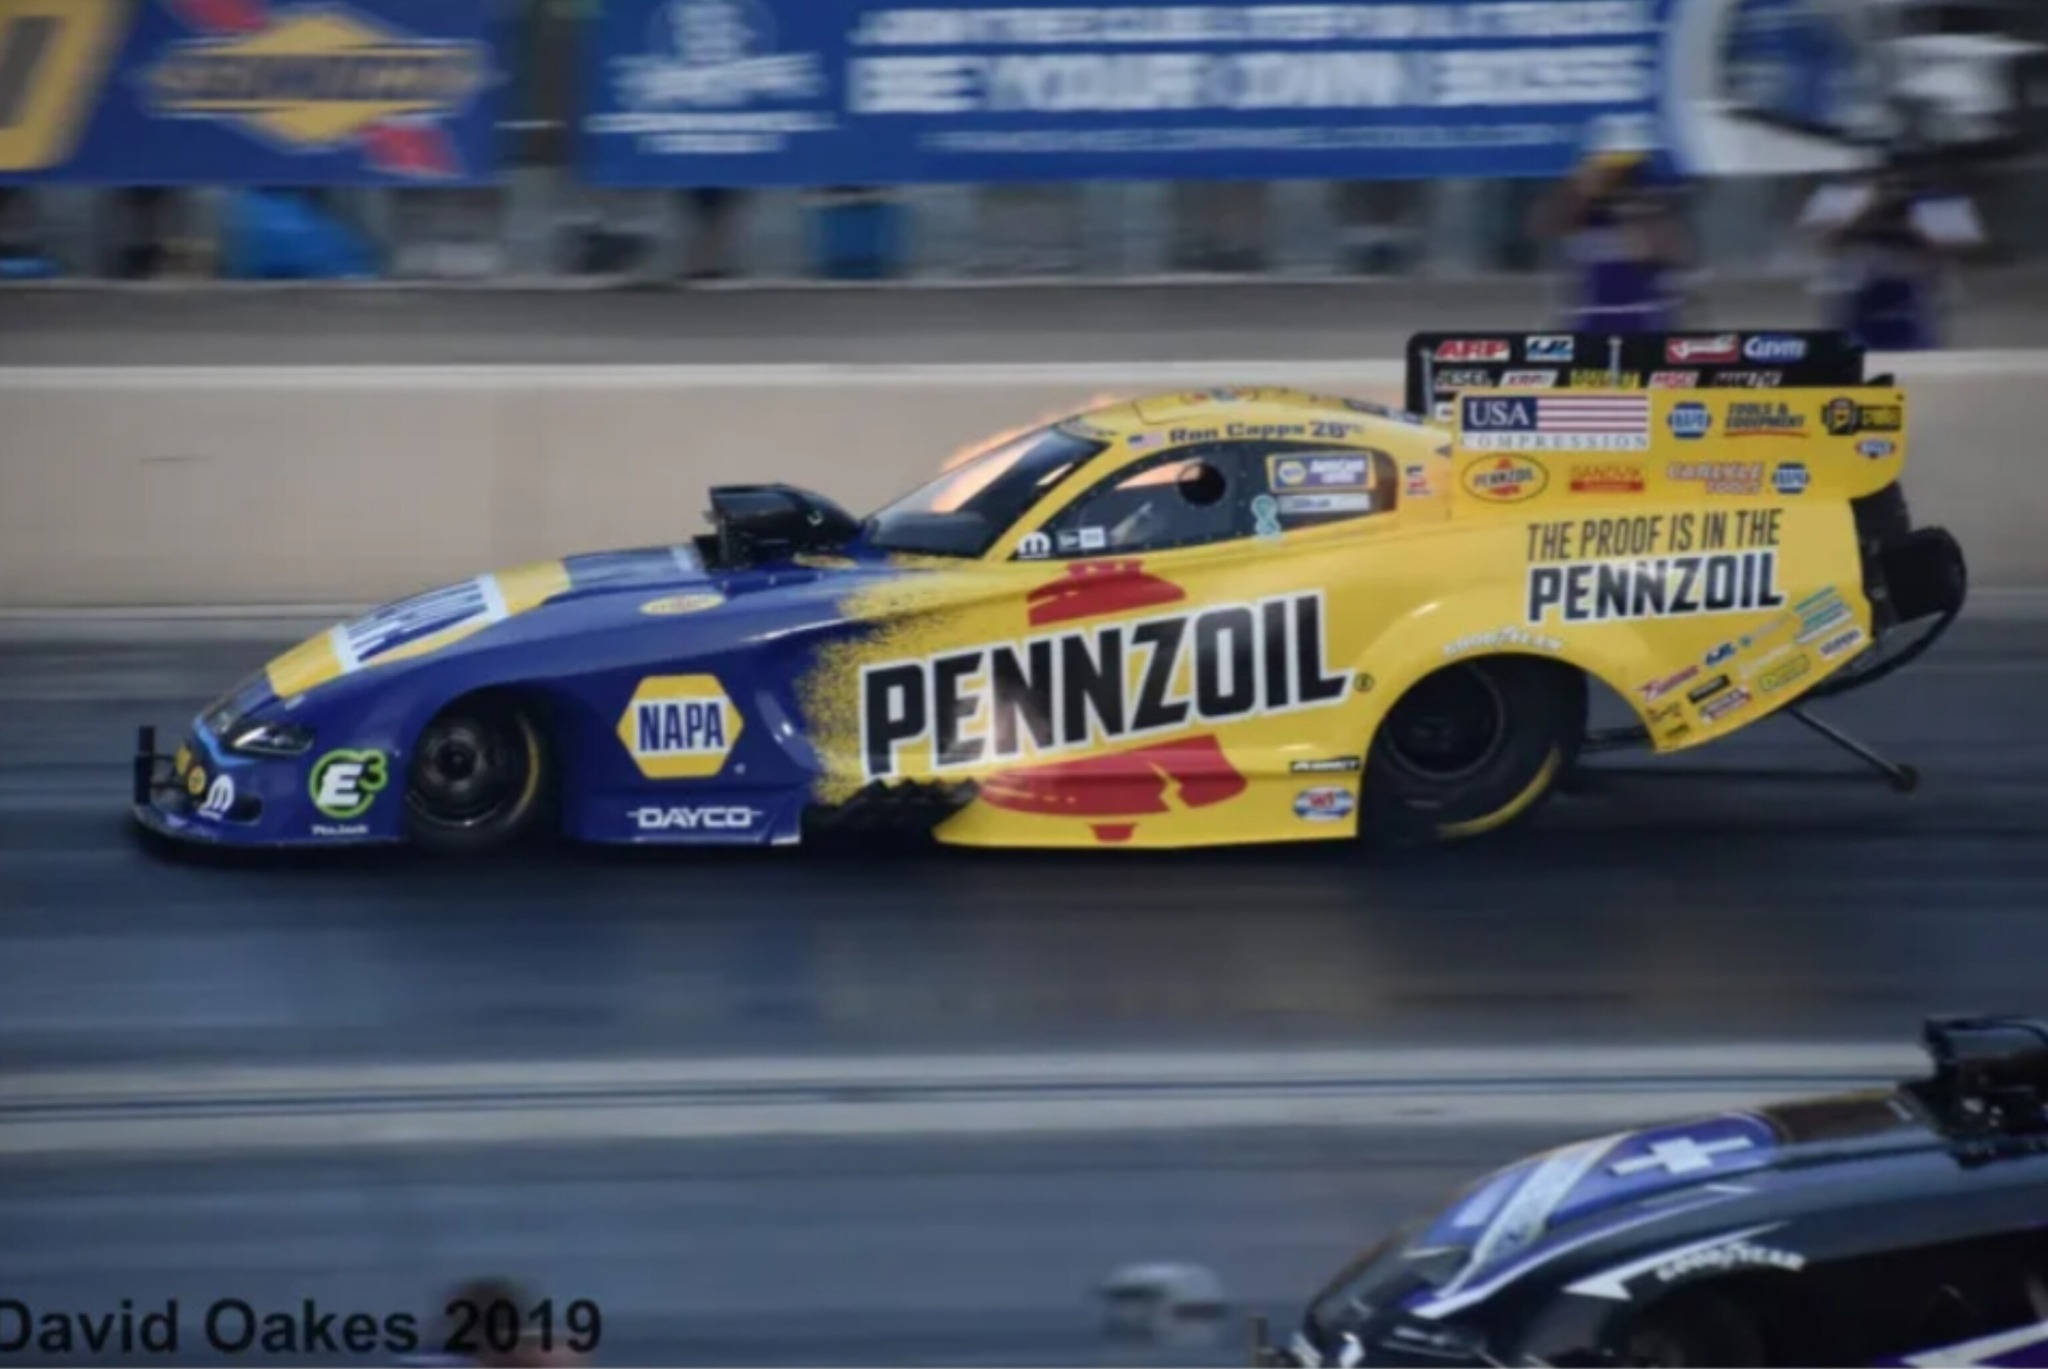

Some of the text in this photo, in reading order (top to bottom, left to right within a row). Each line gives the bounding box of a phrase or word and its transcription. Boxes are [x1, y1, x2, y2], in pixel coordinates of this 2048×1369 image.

[1170, 427, 1219, 443] Ron
[1226, 422, 1306, 441] Capps
[1469, 400, 1529, 427] USA
[1461, 434, 1648, 449] COMPRESSION
[1527, 507, 1783, 561] THE PROOF IS IN THE
[1527, 551, 1785, 623] PENNZOIL
[861, 592, 1350, 776] PENNZOIL
[637, 702, 725, 752] NAPA
[637, 807, 753, 829] DAYCO
